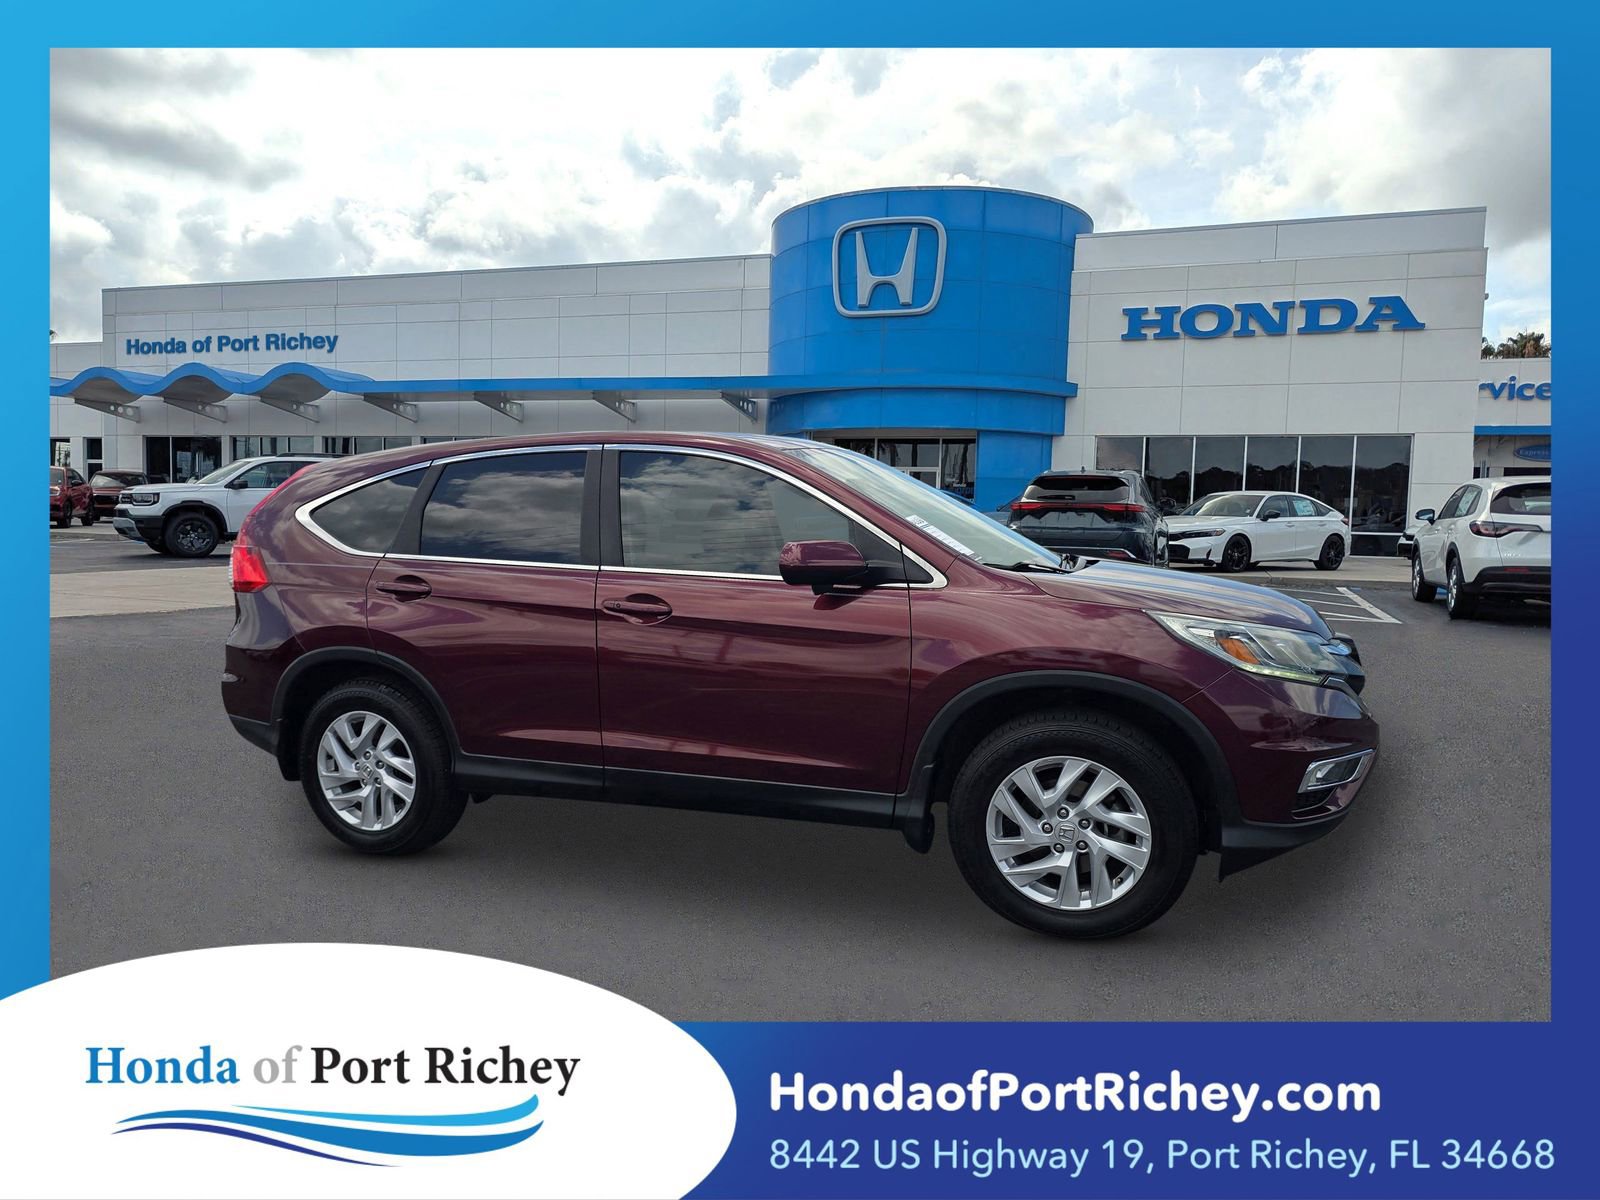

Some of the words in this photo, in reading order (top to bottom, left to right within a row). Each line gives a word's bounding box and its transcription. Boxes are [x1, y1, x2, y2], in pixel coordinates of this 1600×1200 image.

[1120, 295, 1425, 341] HONDA
[125, 337, 187, 355] Honda
[191, 335, 212, 352] of
[217, 334, 260, 352] Port
[265, 332, 338, 354] Richey
